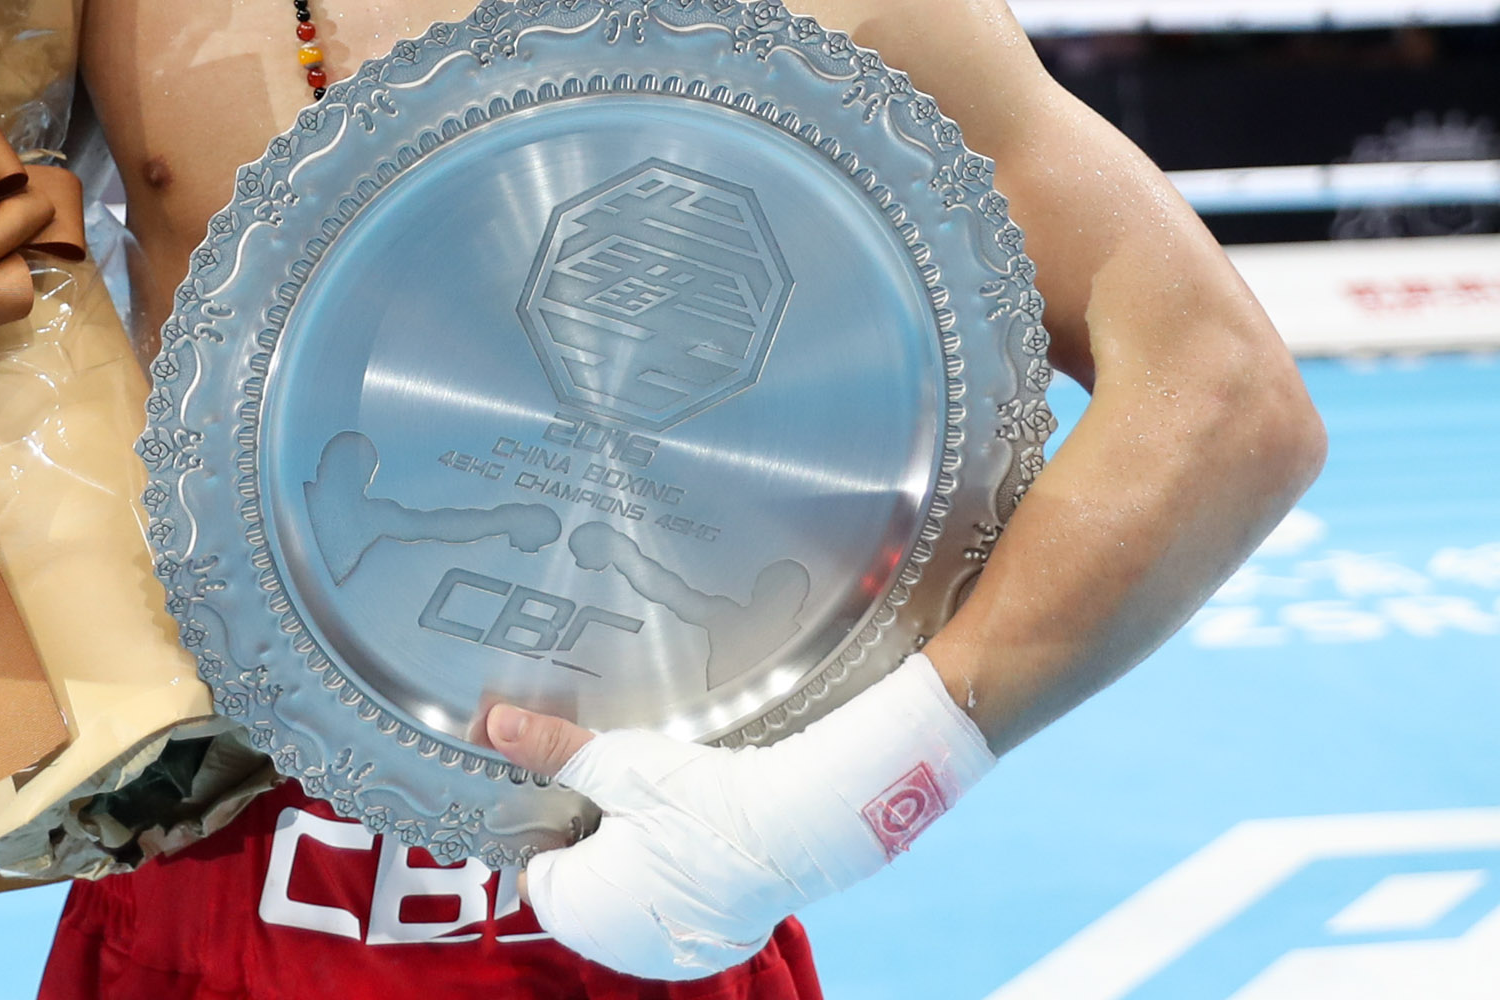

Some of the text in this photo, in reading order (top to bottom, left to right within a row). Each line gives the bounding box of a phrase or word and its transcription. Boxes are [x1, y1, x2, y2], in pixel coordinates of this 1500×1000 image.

[542, 411, 660, 469] 2016
[491, 436, 687, 505] CHINA BOXING
[514, 471, 648, 521] CHAMPIONS
